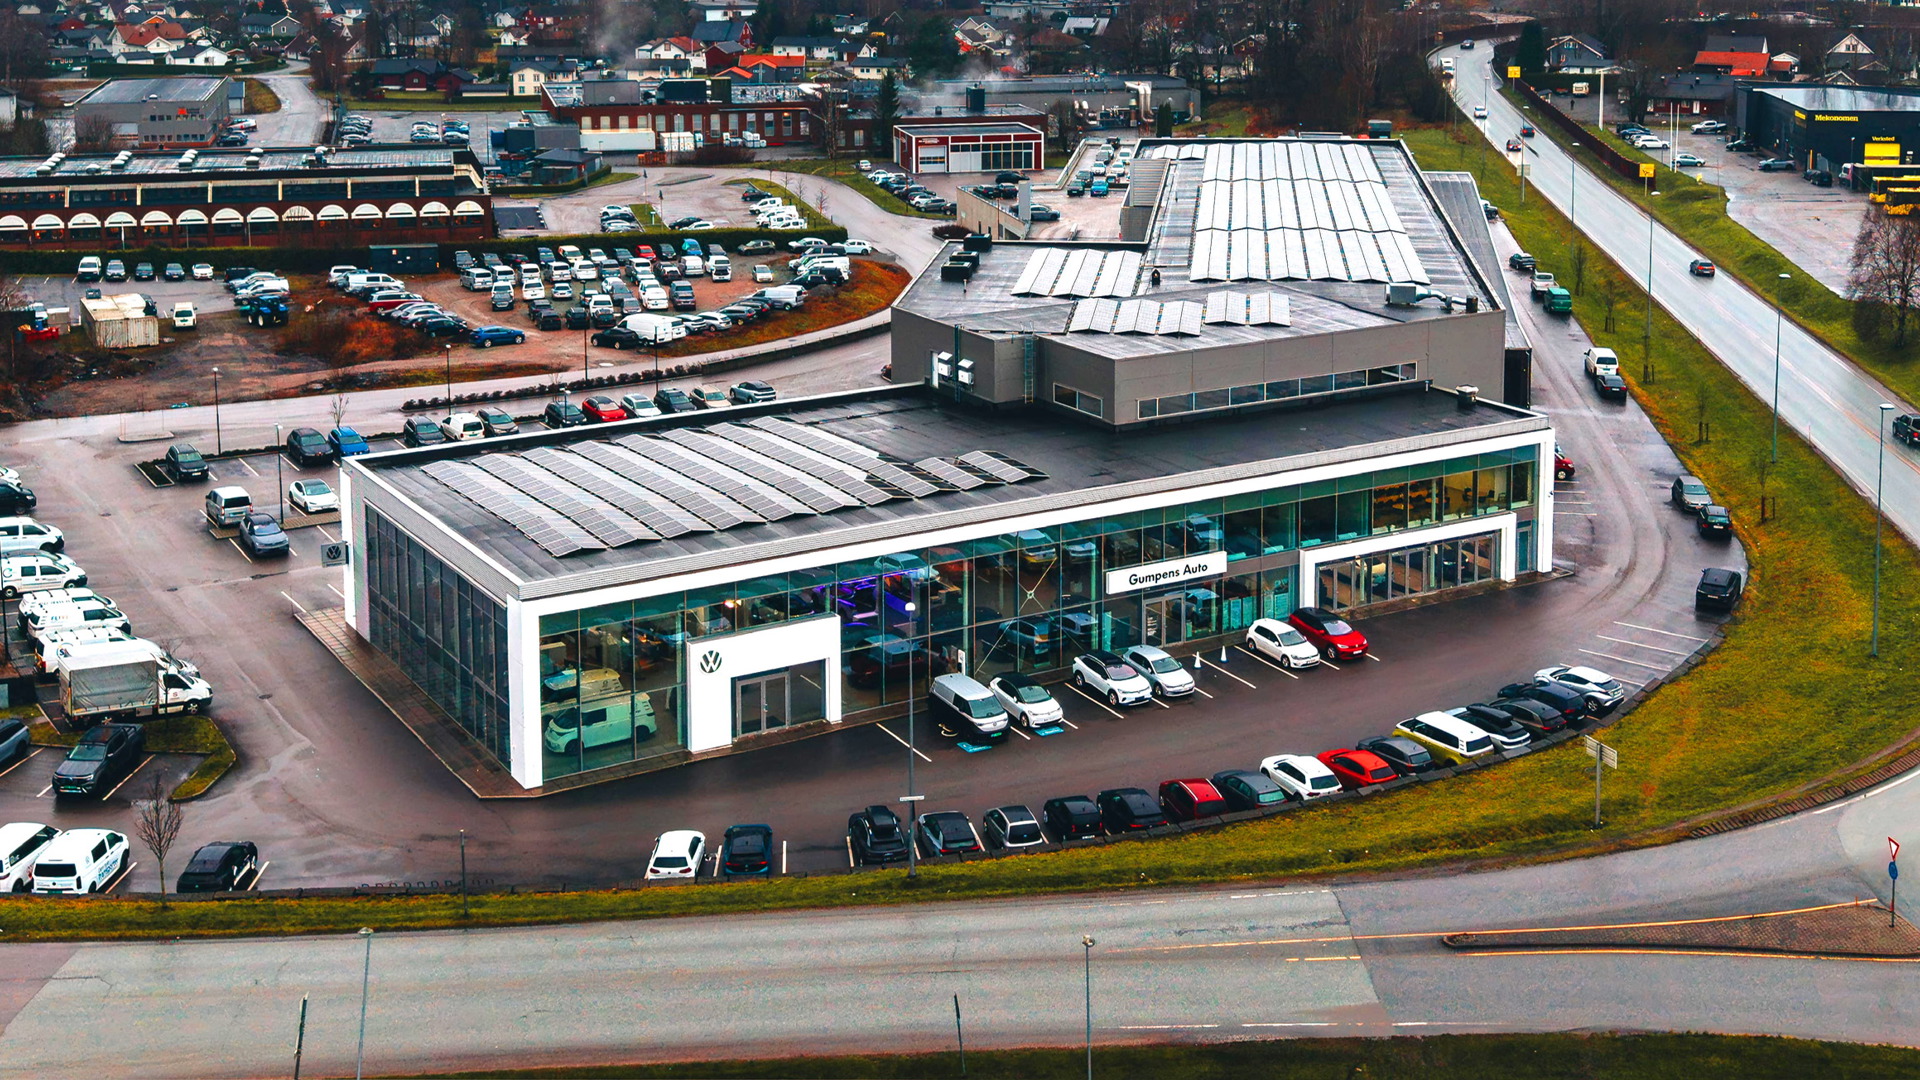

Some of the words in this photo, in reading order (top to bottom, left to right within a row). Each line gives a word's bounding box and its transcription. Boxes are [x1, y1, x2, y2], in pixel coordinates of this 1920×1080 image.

[1129, 569, 1180, 585] Gumpens
[1183, 563, 1209, 576] Auto
[700, 649, 722, 673] VW
